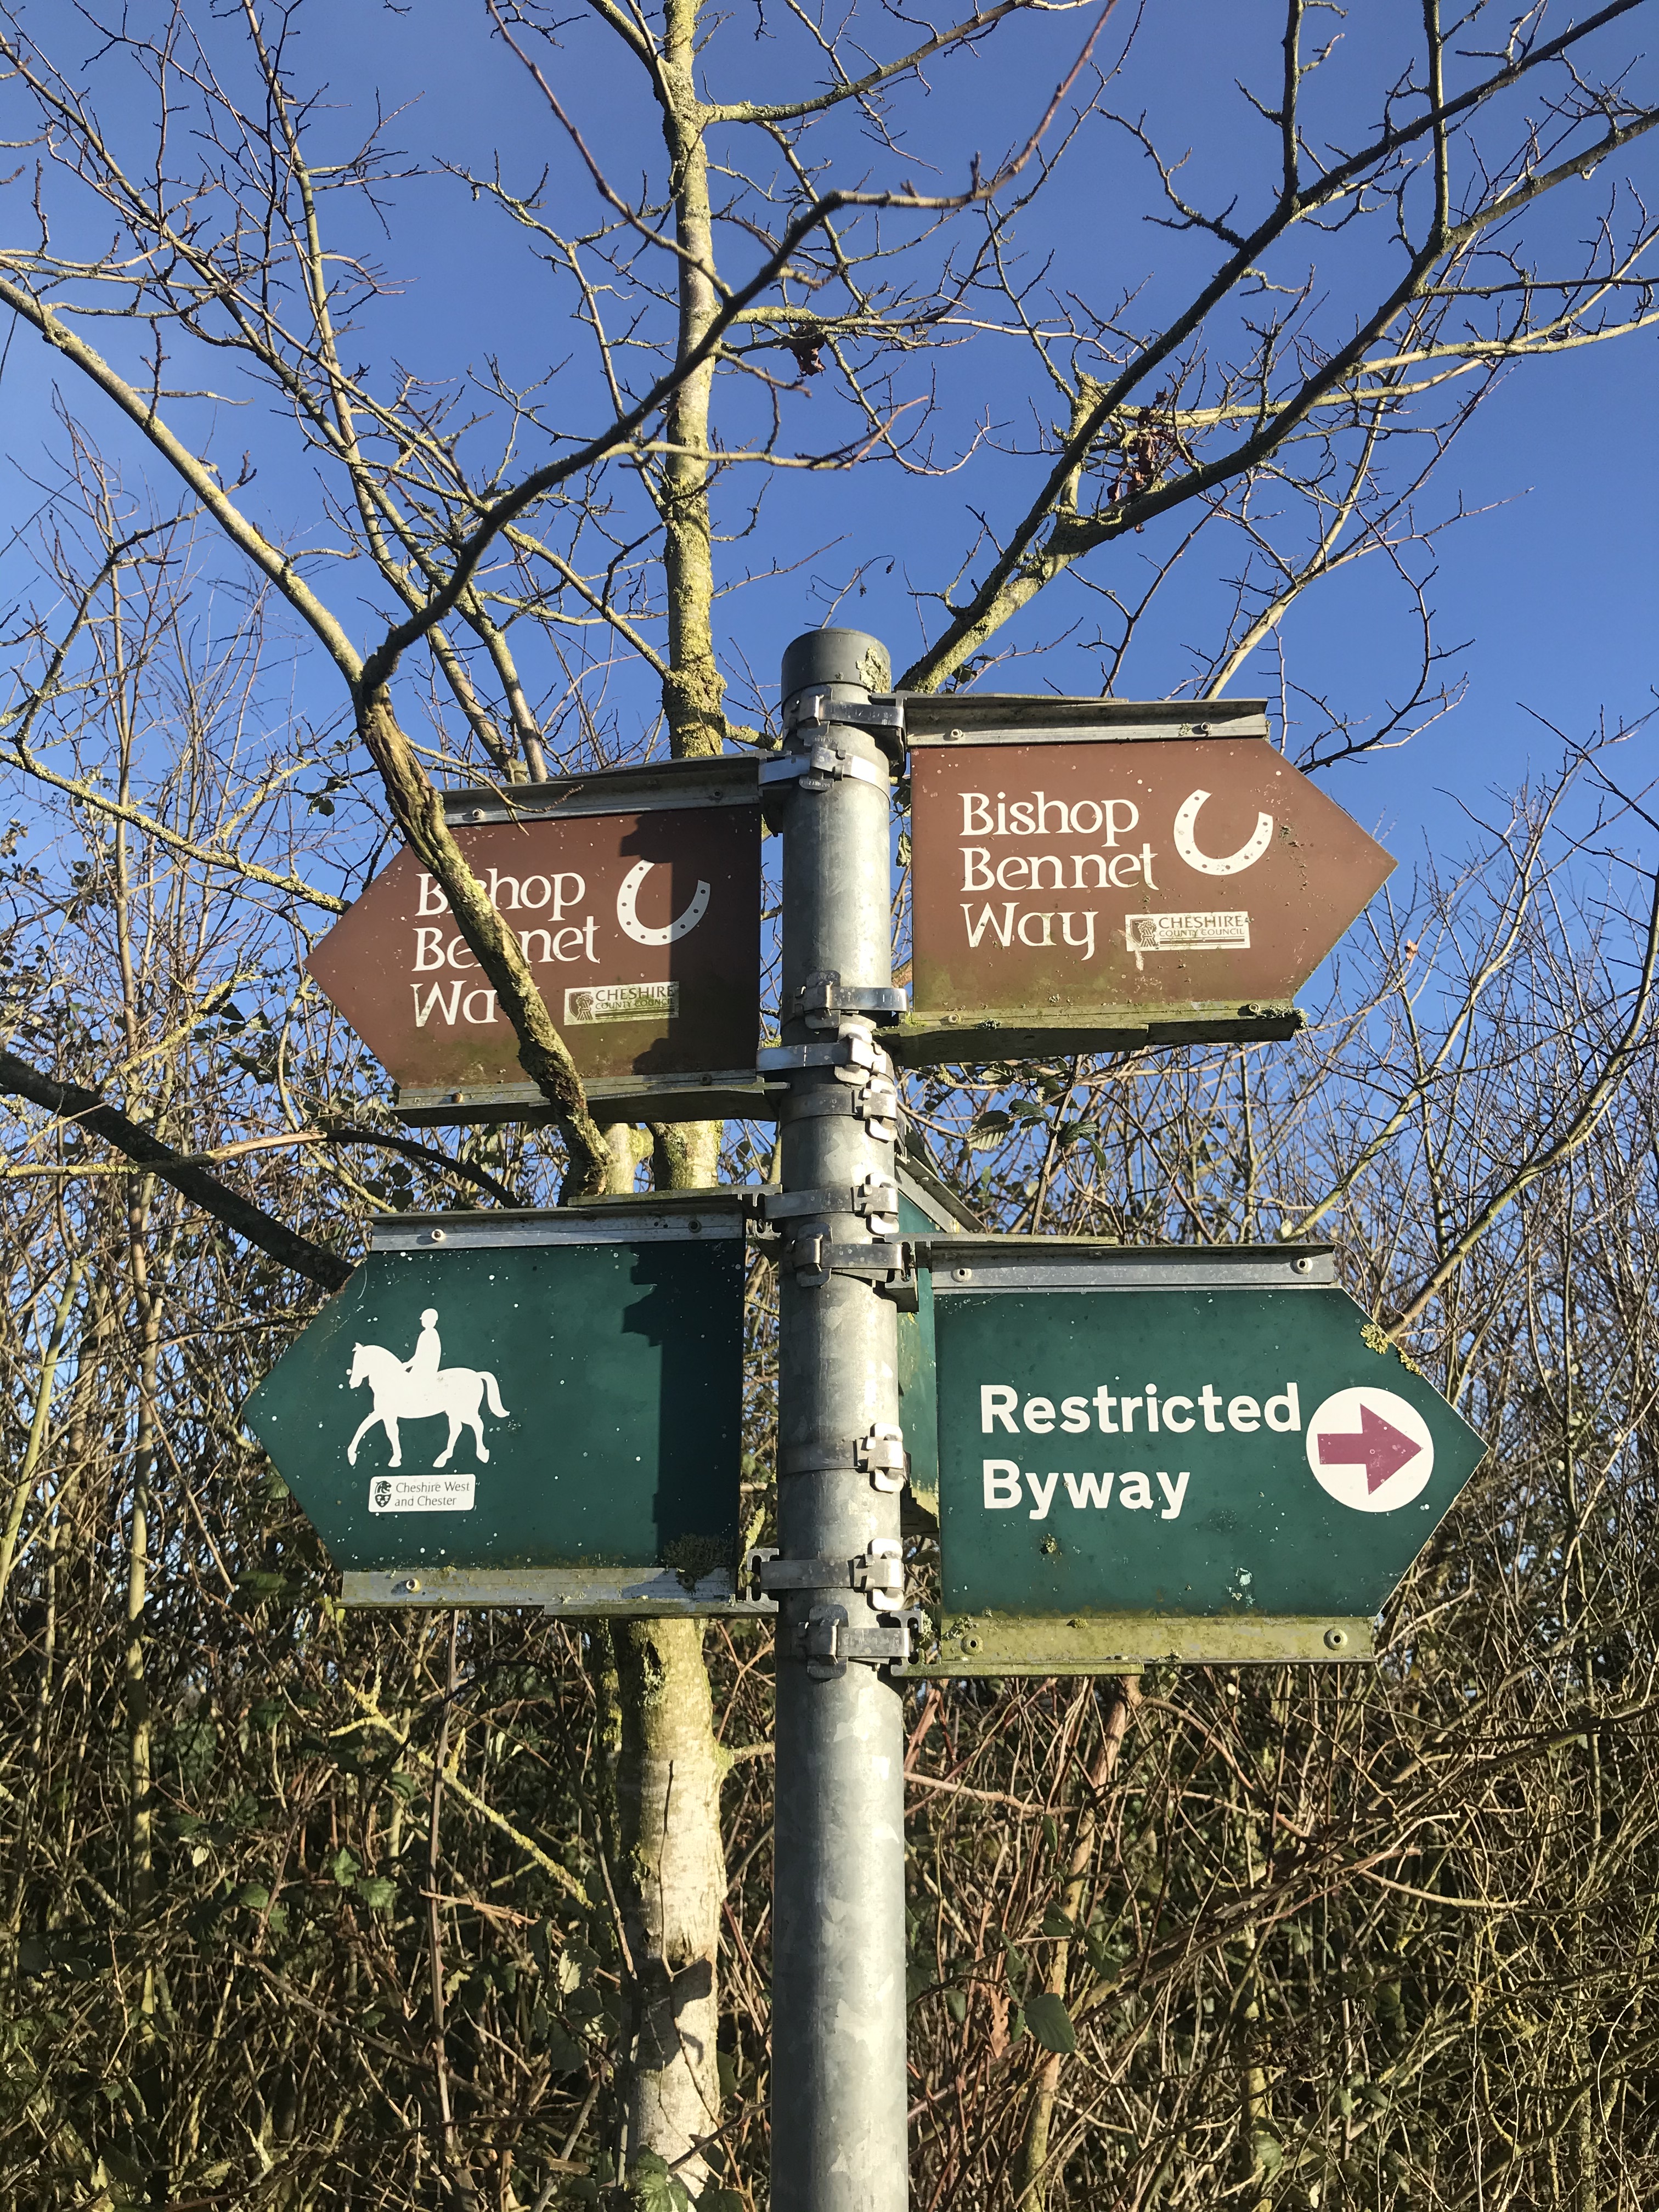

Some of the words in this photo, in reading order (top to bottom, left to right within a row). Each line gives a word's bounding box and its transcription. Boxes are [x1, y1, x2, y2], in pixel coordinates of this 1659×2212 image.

[958, 791, 1138, 847] Bishop
[958, 843, 1159, 891] Bennet
[414, 868, 586, 921] Bhop
[411, 916, 601, 971] Benet
[960, 902, 1098, 961] Way
[1158, 915, 1244, 928] CHESHIRE
[410, 980, 541, 1028] Wa
[595, 985, 675, 1002] CHESHIRE
[595, 1001, 631, 1009] COUNTY
[634, 997, 674, 1007] COUNCIL
[980, 1382, 1301, 1434] Restricted
[394, 1496, 414, 1506] and
[417, 1496, 457, 1506] Chester
[396, 1482, 441, 1493] Cheshire
[444, 1481, 470, 1492] West
[983, 1459, 1190, 1520] Byway
